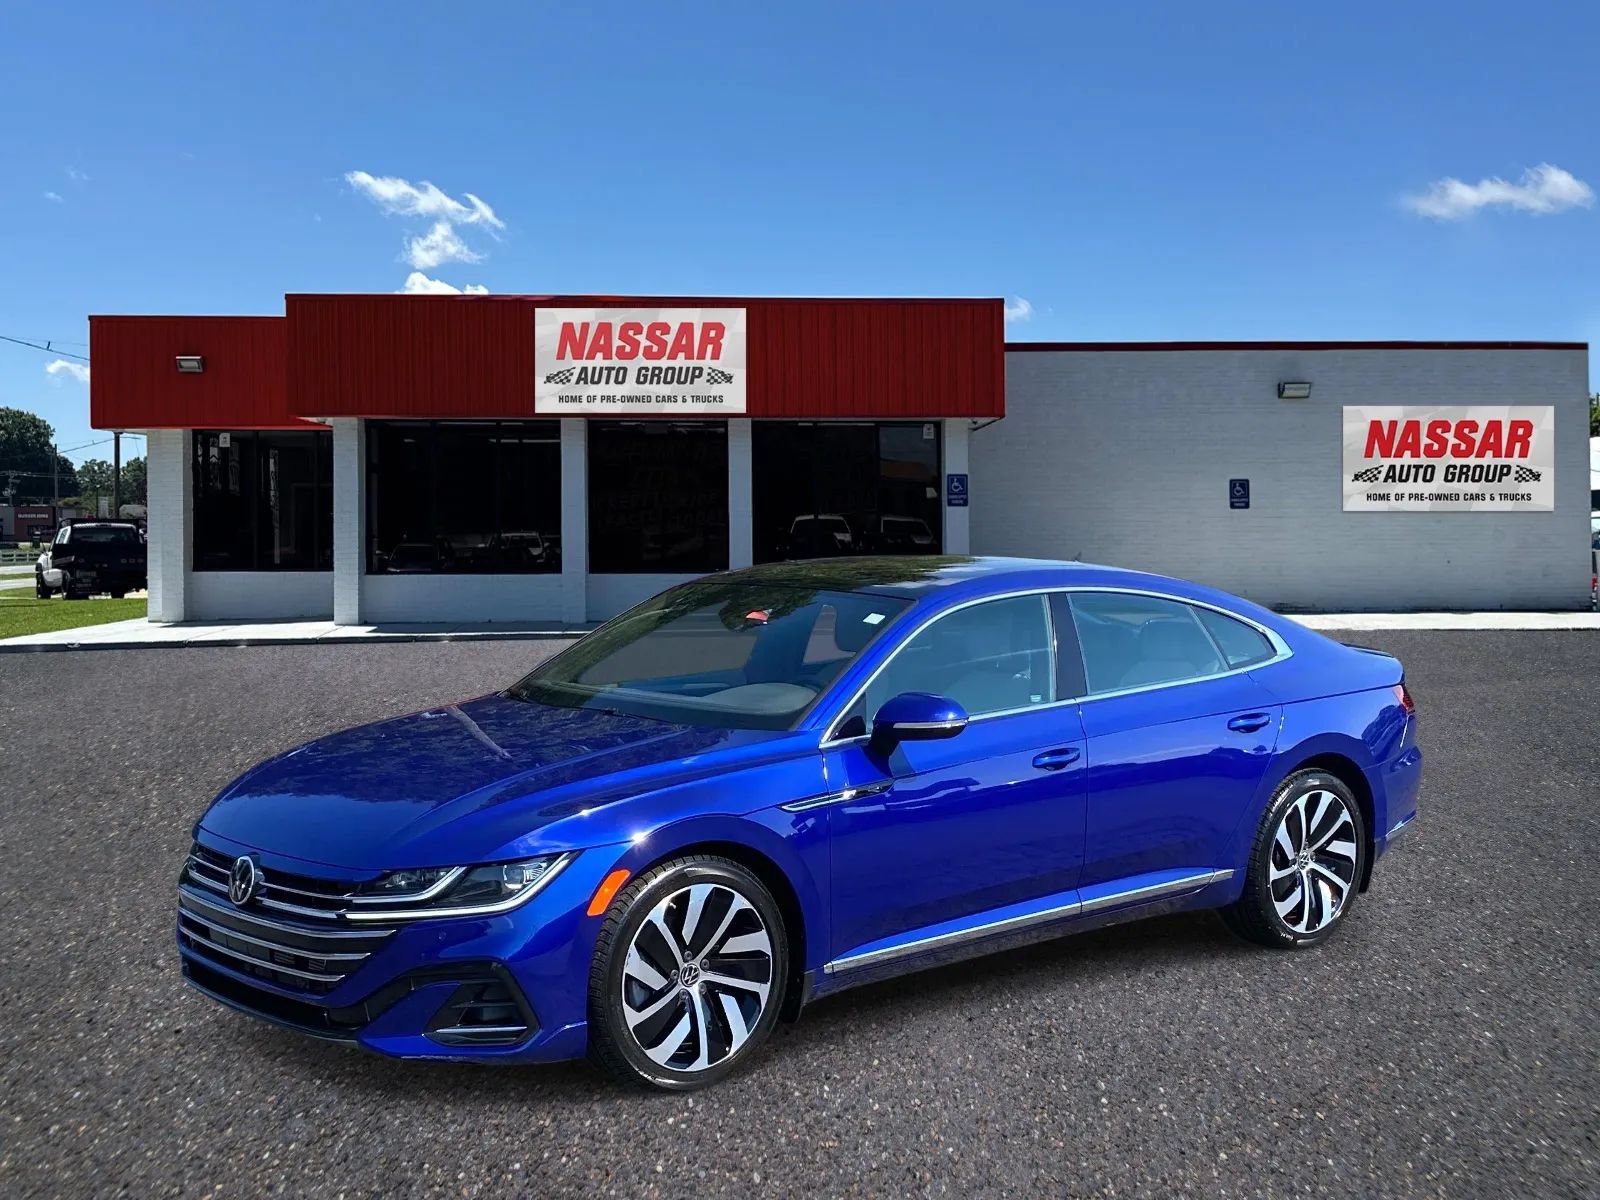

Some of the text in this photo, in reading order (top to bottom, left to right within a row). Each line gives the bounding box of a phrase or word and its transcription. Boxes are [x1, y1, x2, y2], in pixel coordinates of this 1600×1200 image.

[556, 322, 725, 360] NASSAR
[574, 366, 703, 385] AUTO GROUP
[558, 395, 724, 403] HOME OF PRE-OWNED CARS & TRUCKS
[1364, 420, 1533, 458] NASSAR
[1382, 464, 1512, 483] AUTO GROUP
[1366, 493, 1532, 501] HOME OF PRE-OWNED CARS & TRUCKS
